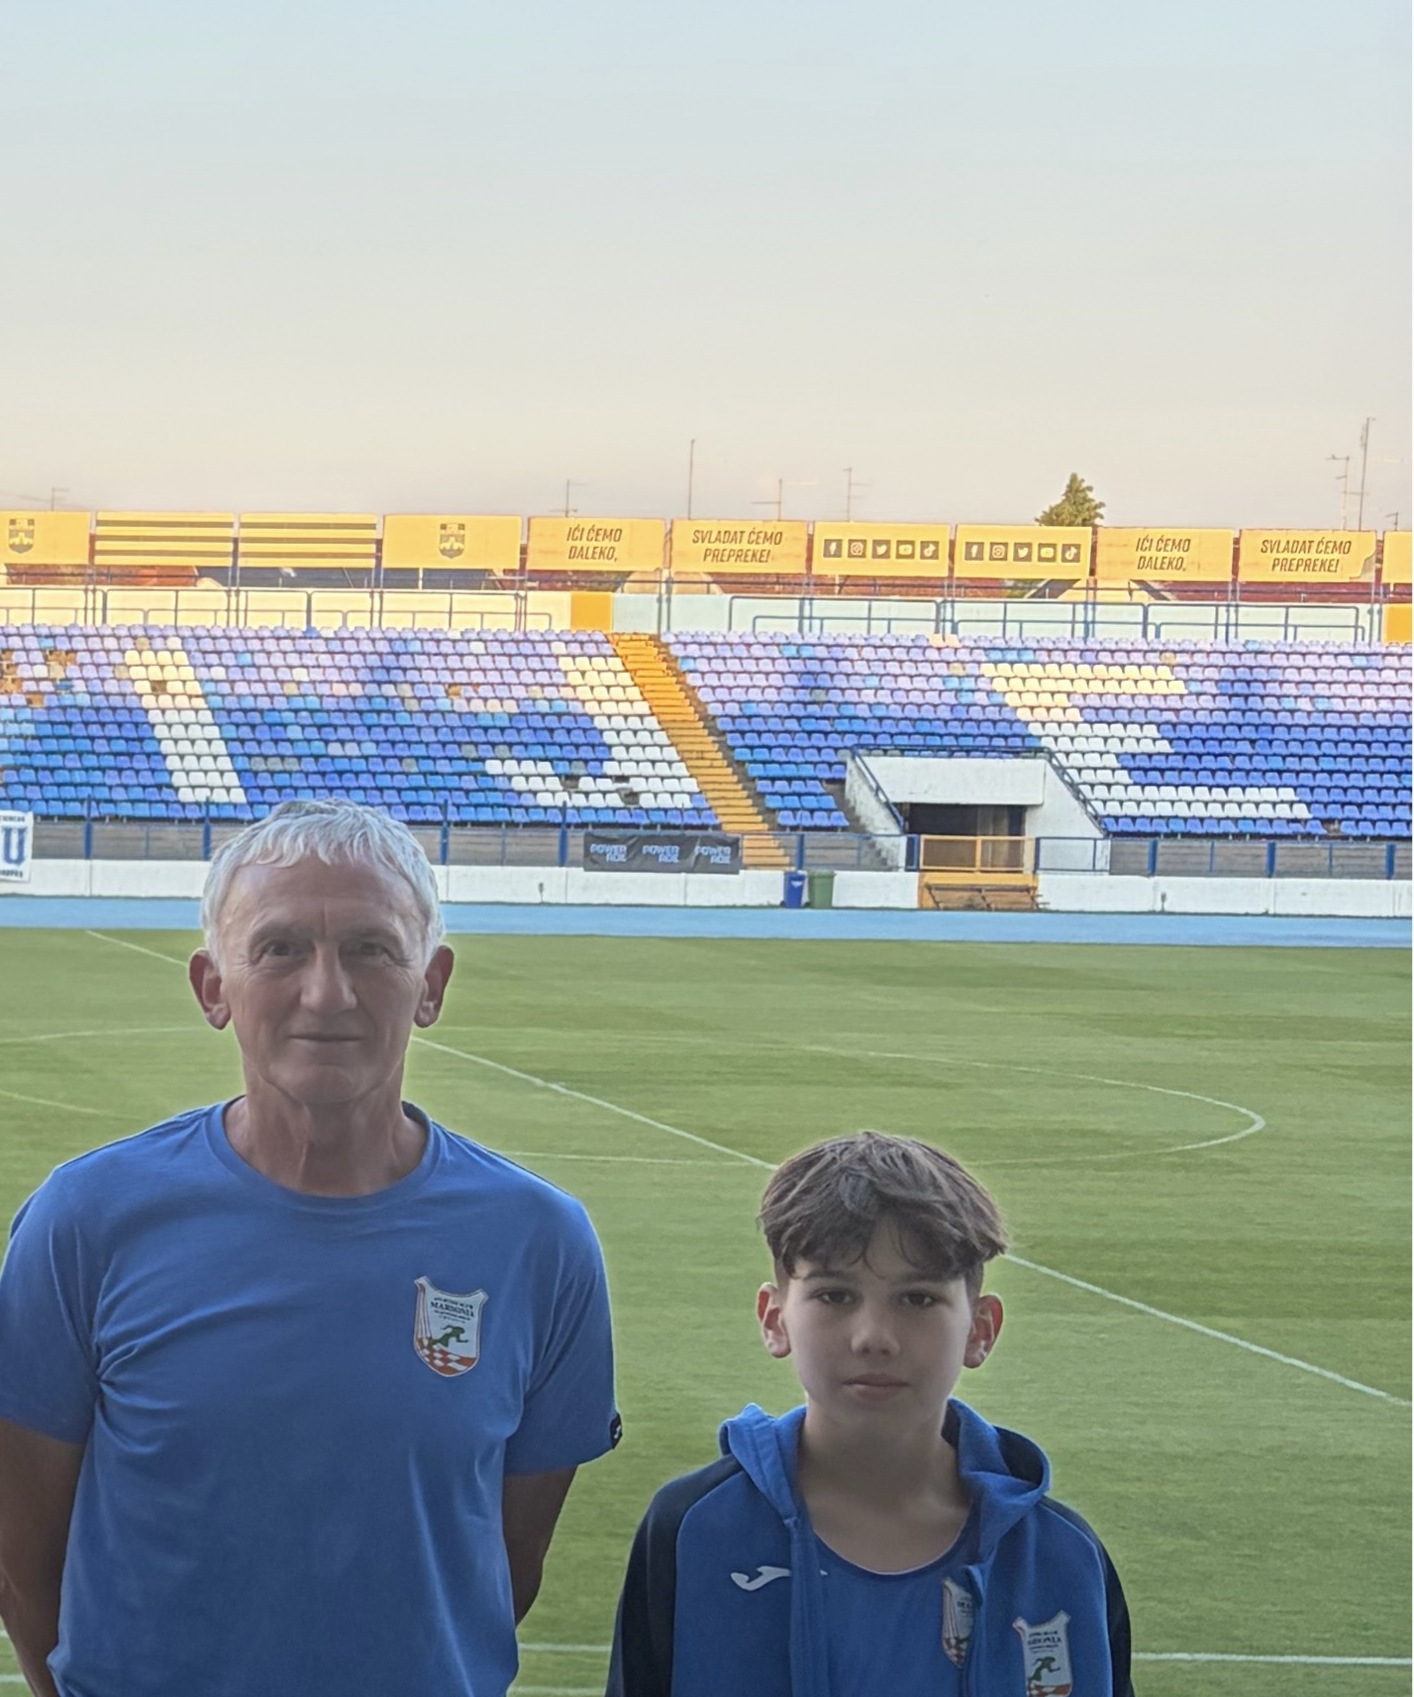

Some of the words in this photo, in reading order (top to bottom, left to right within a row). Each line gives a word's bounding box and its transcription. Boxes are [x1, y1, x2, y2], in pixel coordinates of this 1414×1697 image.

[567, 524, 584, 541] IĆI
[586, 525, 622, 542] ĆEMO
[692, 530, 745, 544] SVLADAT
[747, 528, 783, 545] ĆEMO
[1136, 534, 1153, 552] IĆI
[1155, 535, 1191, 552] ĆEMO
[1261, 540, 1314, 554] SVLADAT
[1316, 537, 1351, 554] ĆEMO
[703, 548, 771, 563] PREPREKE!
[1272, 558, 1339, 572] PREPREKE!
